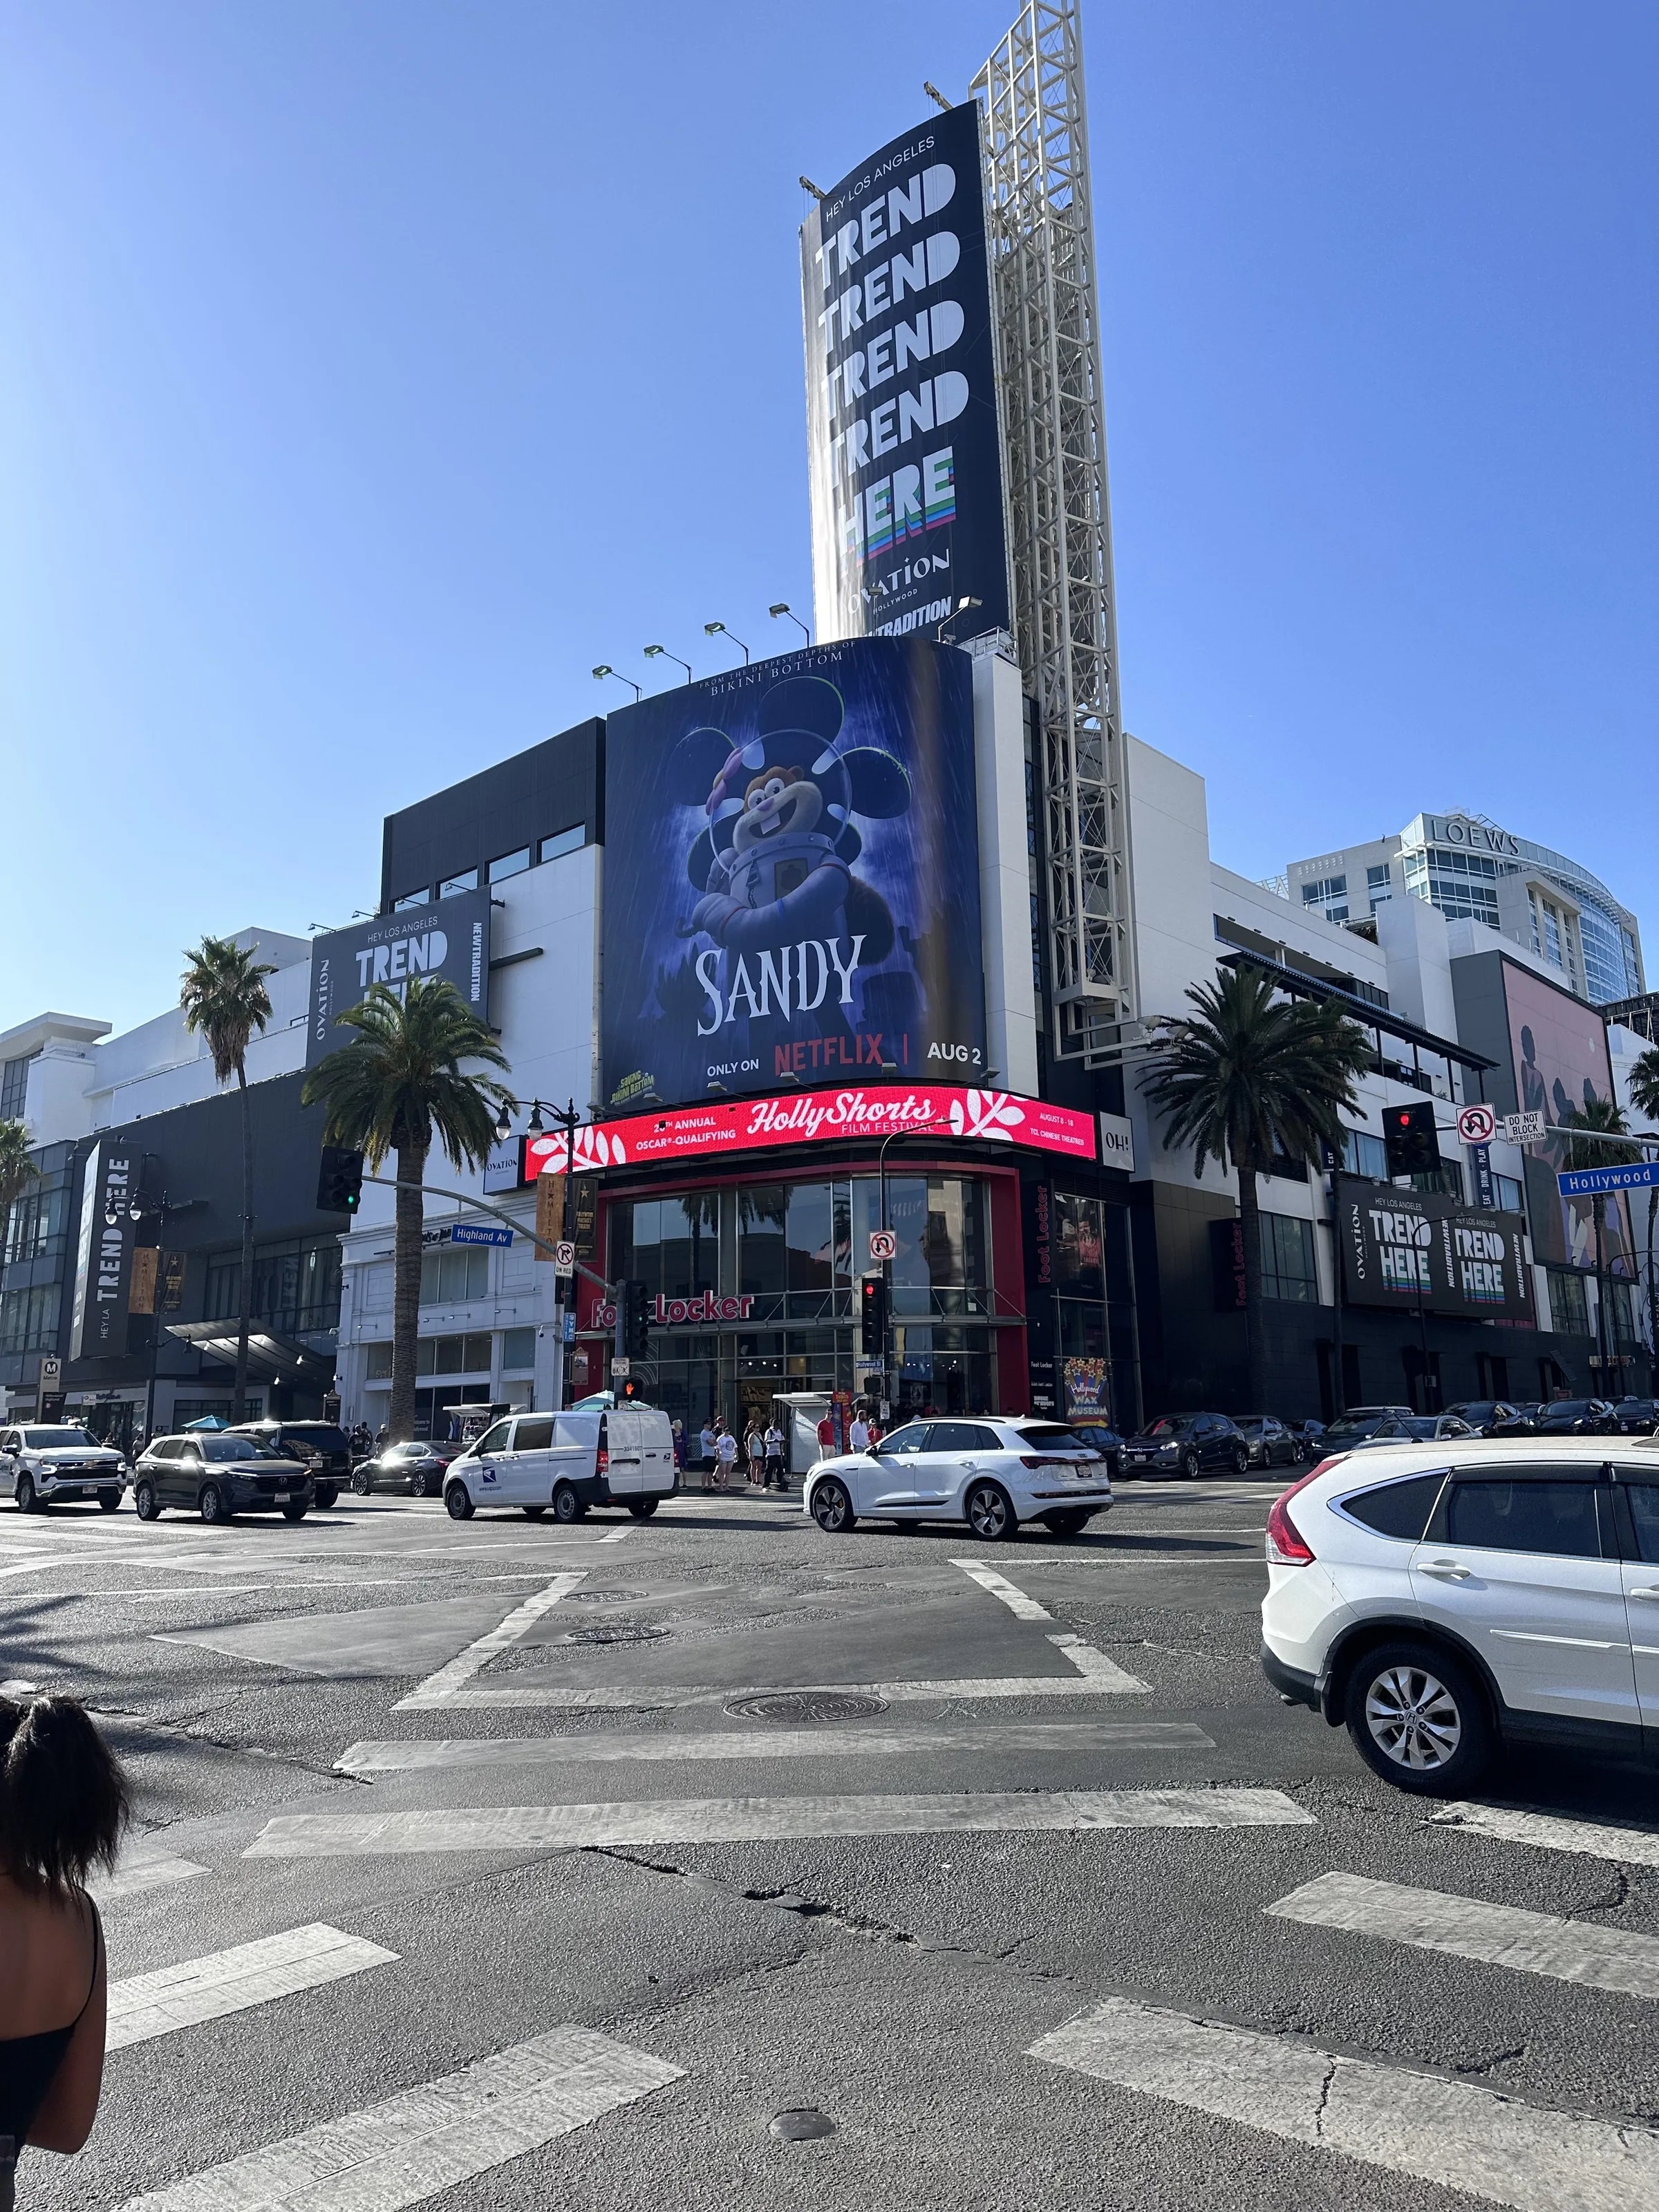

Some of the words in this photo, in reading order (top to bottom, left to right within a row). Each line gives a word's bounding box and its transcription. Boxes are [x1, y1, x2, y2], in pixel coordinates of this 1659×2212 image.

[826, 195, 845, 223] HEY
[849, 176, 870, 201] LOS
[874, 135, 935, 182] ANGELES
[816, 163, 956, 291] TREND
[818, 231, 961, 356] TREND
[821, 300, 965, 422] TREND
[824, 371, 969, 490] TREND
[838, 446, 956, 574] HERE
[847, 548, 950, 615] OVATION
[872, 588, 918, 615] HOLLYWOOD
[700, 676, 724, 689] FROM
[729, 669, 747, 679] THE
[752, 657, 793, 673] DEEPEST
[798, 644, 836, 659] DEPTHS
[711, 673, 762, 697] BIKINI
[771, 651, 843, 678] BOTTOM
[1432, 819, 1520, 856] LOEWS
[368, 932, 382, 944] HEY
[384, 926, 400, 939] LOS
[402, 916, 439, 934] ANGELES
[355, 930, 448, 987] TREND
[470, 922, 482, 1002] NEWTRADITION
[316, 959, 330, 1040] OVATION
[695, 935, 868, 1036] SANDY
[707, 1060, 739, 1077] ONLY
[740, 1058, 760, 1070] ON
[775, 1034, 883, 1076] NETFLIX
[927, 1042, 969, 1062] AUG
[972, 1047, 982, 1065] 2
[675, 1116, 716, 1130] ANNUAL
[747, 1092, 937, 1138] HollyShorts
[842, 1121, 870, 1134] FILM
[874, 1120, 935, 1134] FESTIVAL
[1040, 1113, 1060, 1124] AUGUST
[1509, 1116, 1520, 1125] DO
[1524, 1113, 1539, 1123] NOT
[1512, 1124, 1539, 1136] BLOCK
[1030, 1127, 1039, 1136] TCL
[1040, 1130, 1061, 1141] CHINESE
[1061, 1134, 1085, 1146] THEATRES
[1105, 1132, 1129, 1152] OH!
[1508, 1132, 1545, 1143] INTERSECTION
[487, 1157, 518, 1172] OVATION
[1477, 1148, 1486, 1163] PLAY
[1480, 1170, 1490, 1188] DRINK
[1569, 1168, 1651, 1190] Hollywood
[1035, 1185, 1050, 1241] Locker
[1376, 1197, 1386, 1206] HEY
[1387, 1199, 1398, 1208] LOS
[1398, 1201, 1423, 1211] ANGELES
[1483, 1194, 1491, 1205] EAT
[457, 1228, 494, 1242] Highland
[496, 1232, 508, 1243] Av
[1369, 1210, 1432, 1247] TREND
[1476, 1219, 1497, 1228] ANGELES
[1230, 1222, 1245, 1271] Locker
[1351, 1203, 1366, 1280] OVATION
[1454, 1228, 1505, 1261] TREND
[97, 1228, 123, 1302] TREND
[1038, 1246, 1051, 1283] Foot
[1379, 1246, 1432, 1290] HERE
[1461, 1261, 1505, 1300] HERE
[1512, 1233, 1526, 1298] NEWTRADITION
[1235, 1274, 1246, 1306] Foot
[102, 1309, 110, 1320] LA
[656, 1290, 755, 1324] Locker
[46, 1363, 56, 1373] M
[1070, 1382, 1100, 1396] Hollywood
[1074, 1396, 1098, 1405] WAX
[1067, 1405, 1108, 1416] MUSEUM
